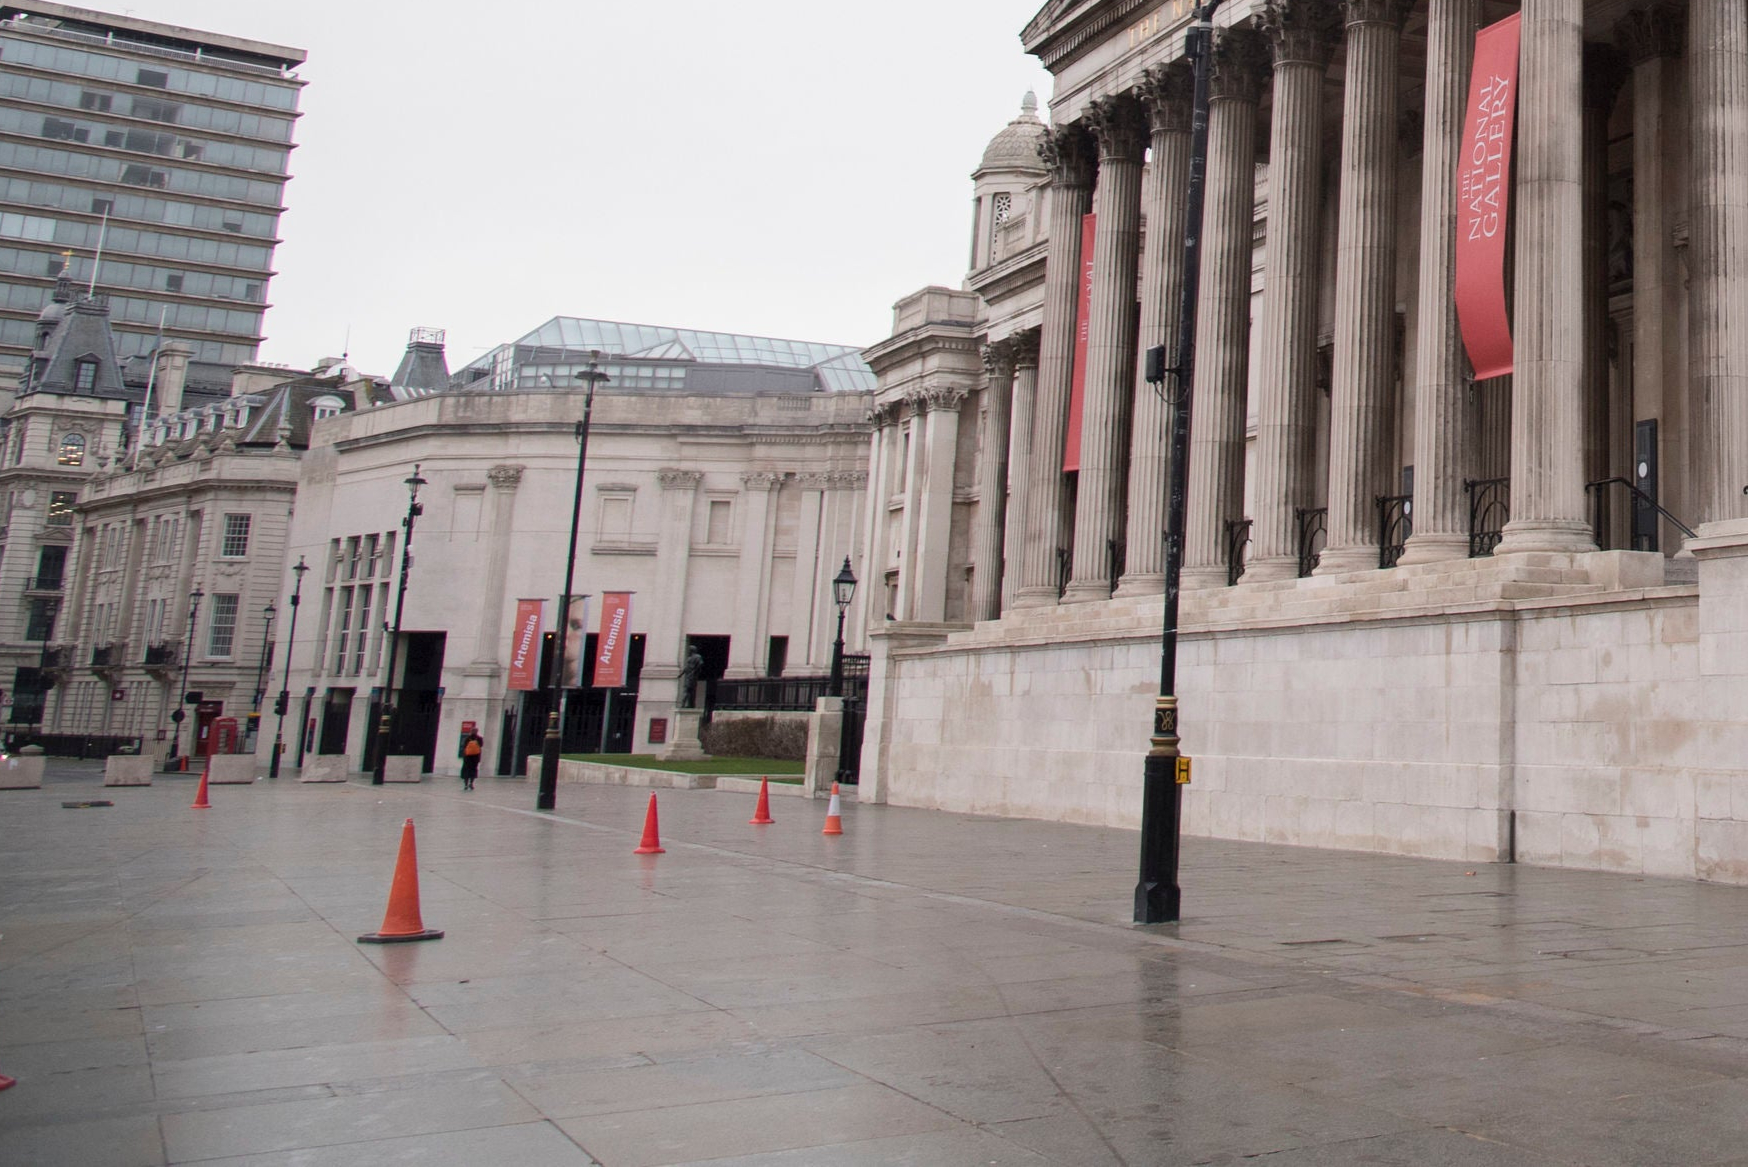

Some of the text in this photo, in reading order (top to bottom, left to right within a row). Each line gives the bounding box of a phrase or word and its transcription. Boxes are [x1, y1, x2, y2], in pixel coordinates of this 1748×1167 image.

[1469, 76, 1493, 242] NATIONAL
[1482, 74, 1509, 237] GALLERY
[1462, 170, 1470, 202] THE
[514, 615, 538, 668] Artemisia
[600, 608, 625, 664] Artemisia
